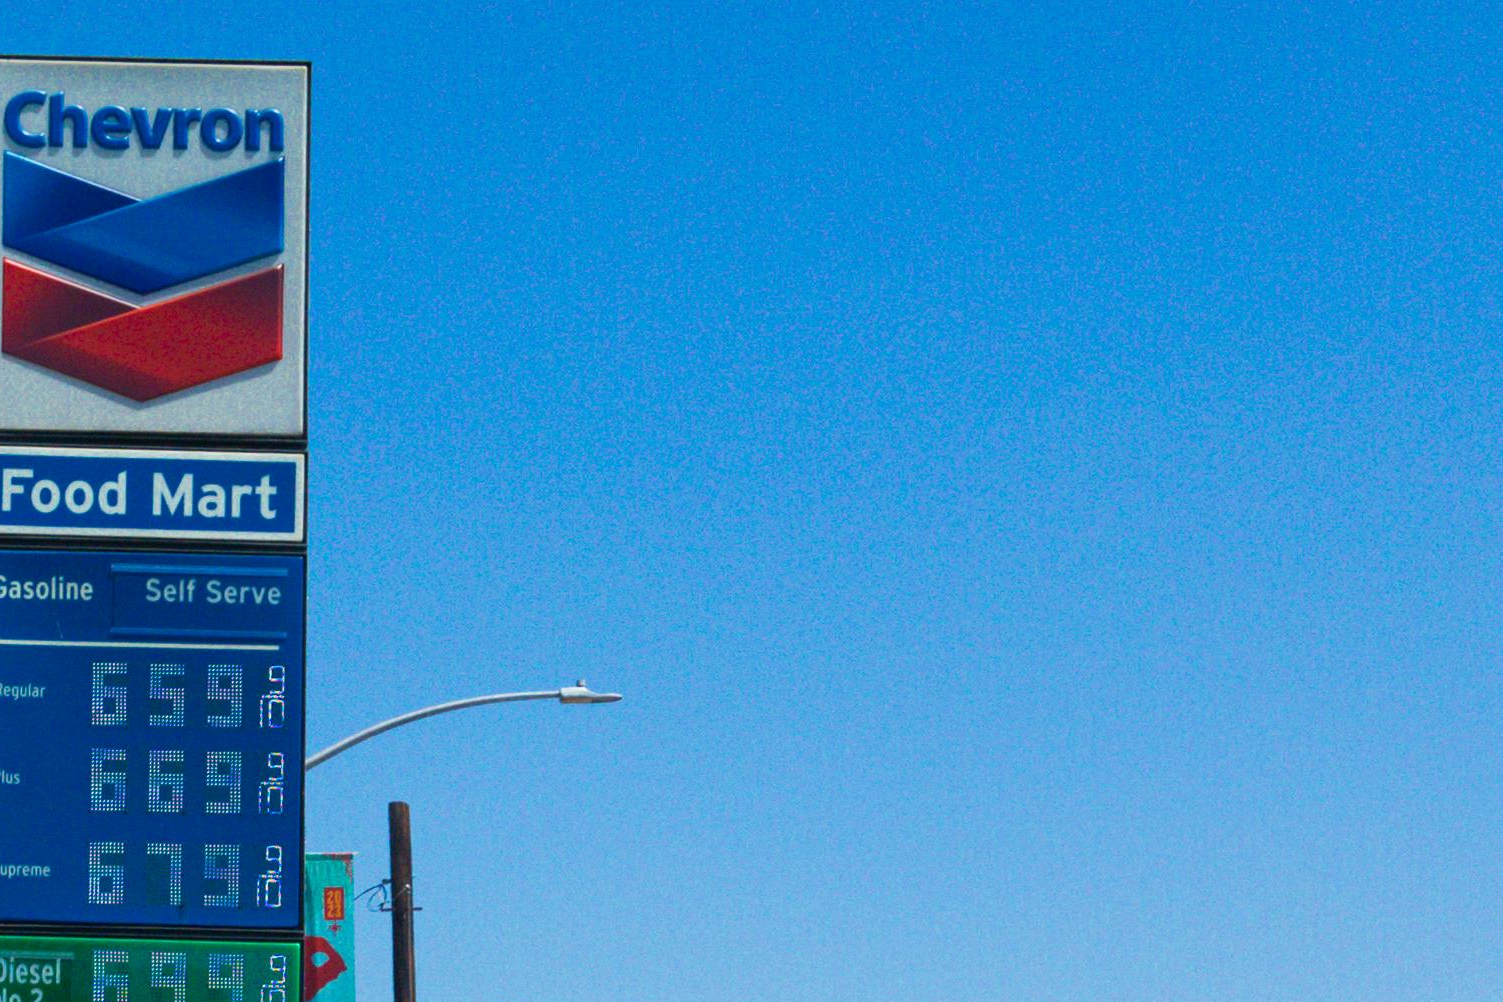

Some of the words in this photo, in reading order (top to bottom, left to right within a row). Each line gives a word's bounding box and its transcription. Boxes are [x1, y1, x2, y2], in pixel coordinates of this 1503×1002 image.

[3, 89, 285, 152] Chevron
[1, 468, 128, 515] Food
[152, 472, 278, 519] Mart
[145, 578, 196, 603] Self
[205, 580, 282, 605] Serve
